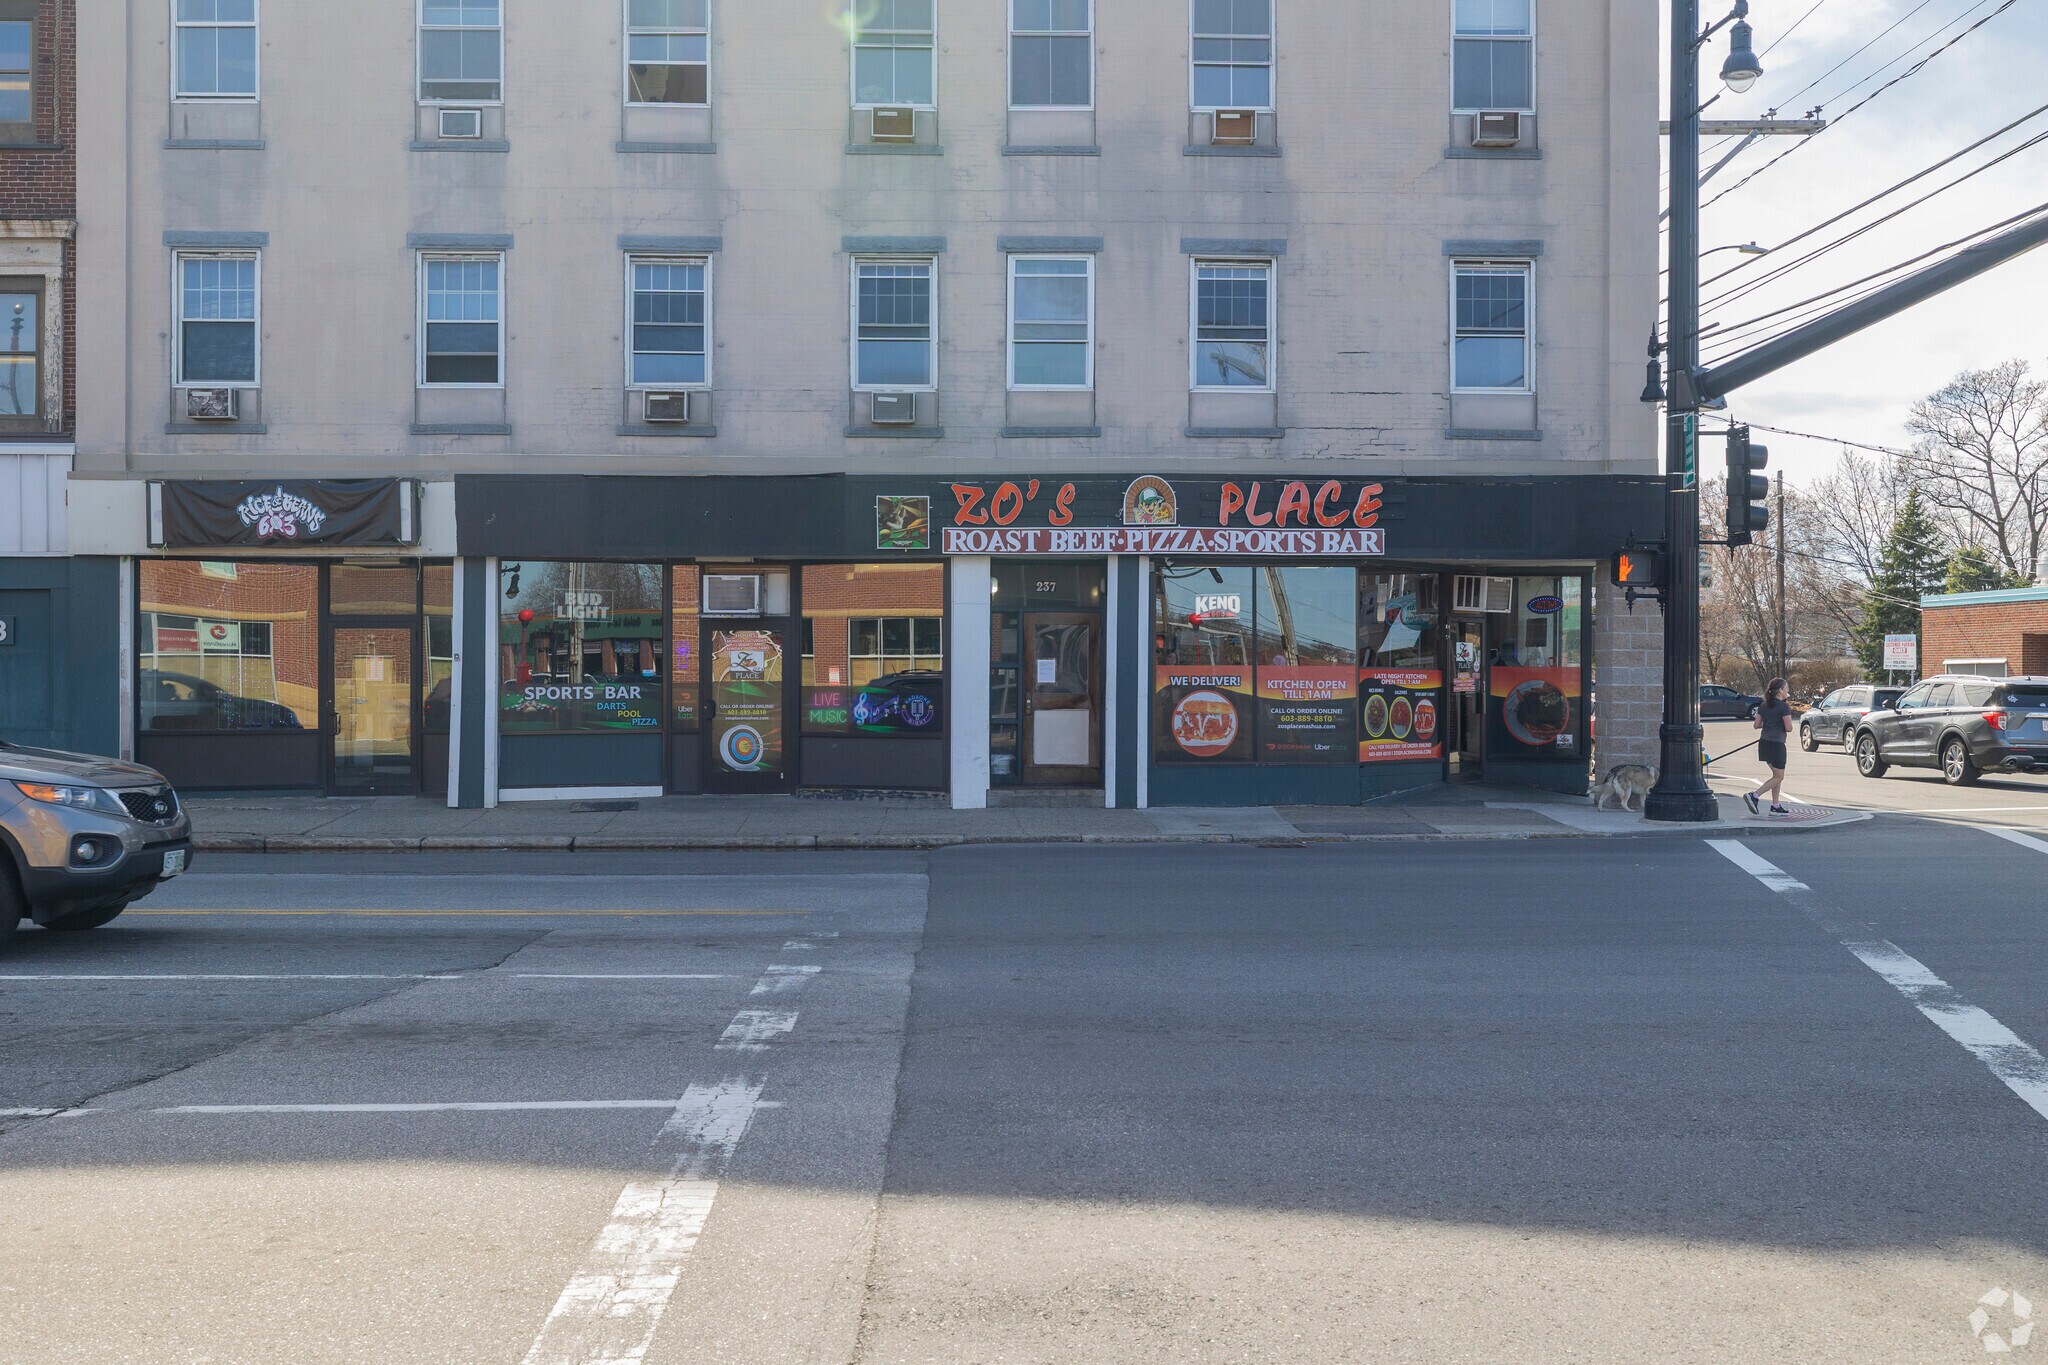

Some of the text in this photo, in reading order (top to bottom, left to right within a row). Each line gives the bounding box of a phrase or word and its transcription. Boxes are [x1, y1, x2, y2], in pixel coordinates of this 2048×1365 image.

[951, 479, 1384, 527] ZO'S PLACE
[238, 494, 274, 525] RICE
[282, 494, 326, 532] BEANS
[948, 530, 1040, 552] ROAST
[1048, 530, 1119, 552] BEEF
[1214, 530, 1316, 553] SPORTS
[1322, 531, 1380, 553] BAR
[1036, 582, 1056, 592] 237
[564, 592, 602, 606] BUD
[1196, 596, 1240, 615] KENO
[557, 606, 610, 619] LIGHT
[1170, 676, 1240, 686] WE DELIVER!
[1268, 680, 1346, 689] KITCHEN OPEN
[524, 686, 641, 700] SPORTS BAR
[814, 693, 840, 706] LIVE
[1283, 690, 1331, 698] TILL 1AM
[904, 695, 931, 705] KARAOKE
[810, 710, 847, 723] MUSIC
